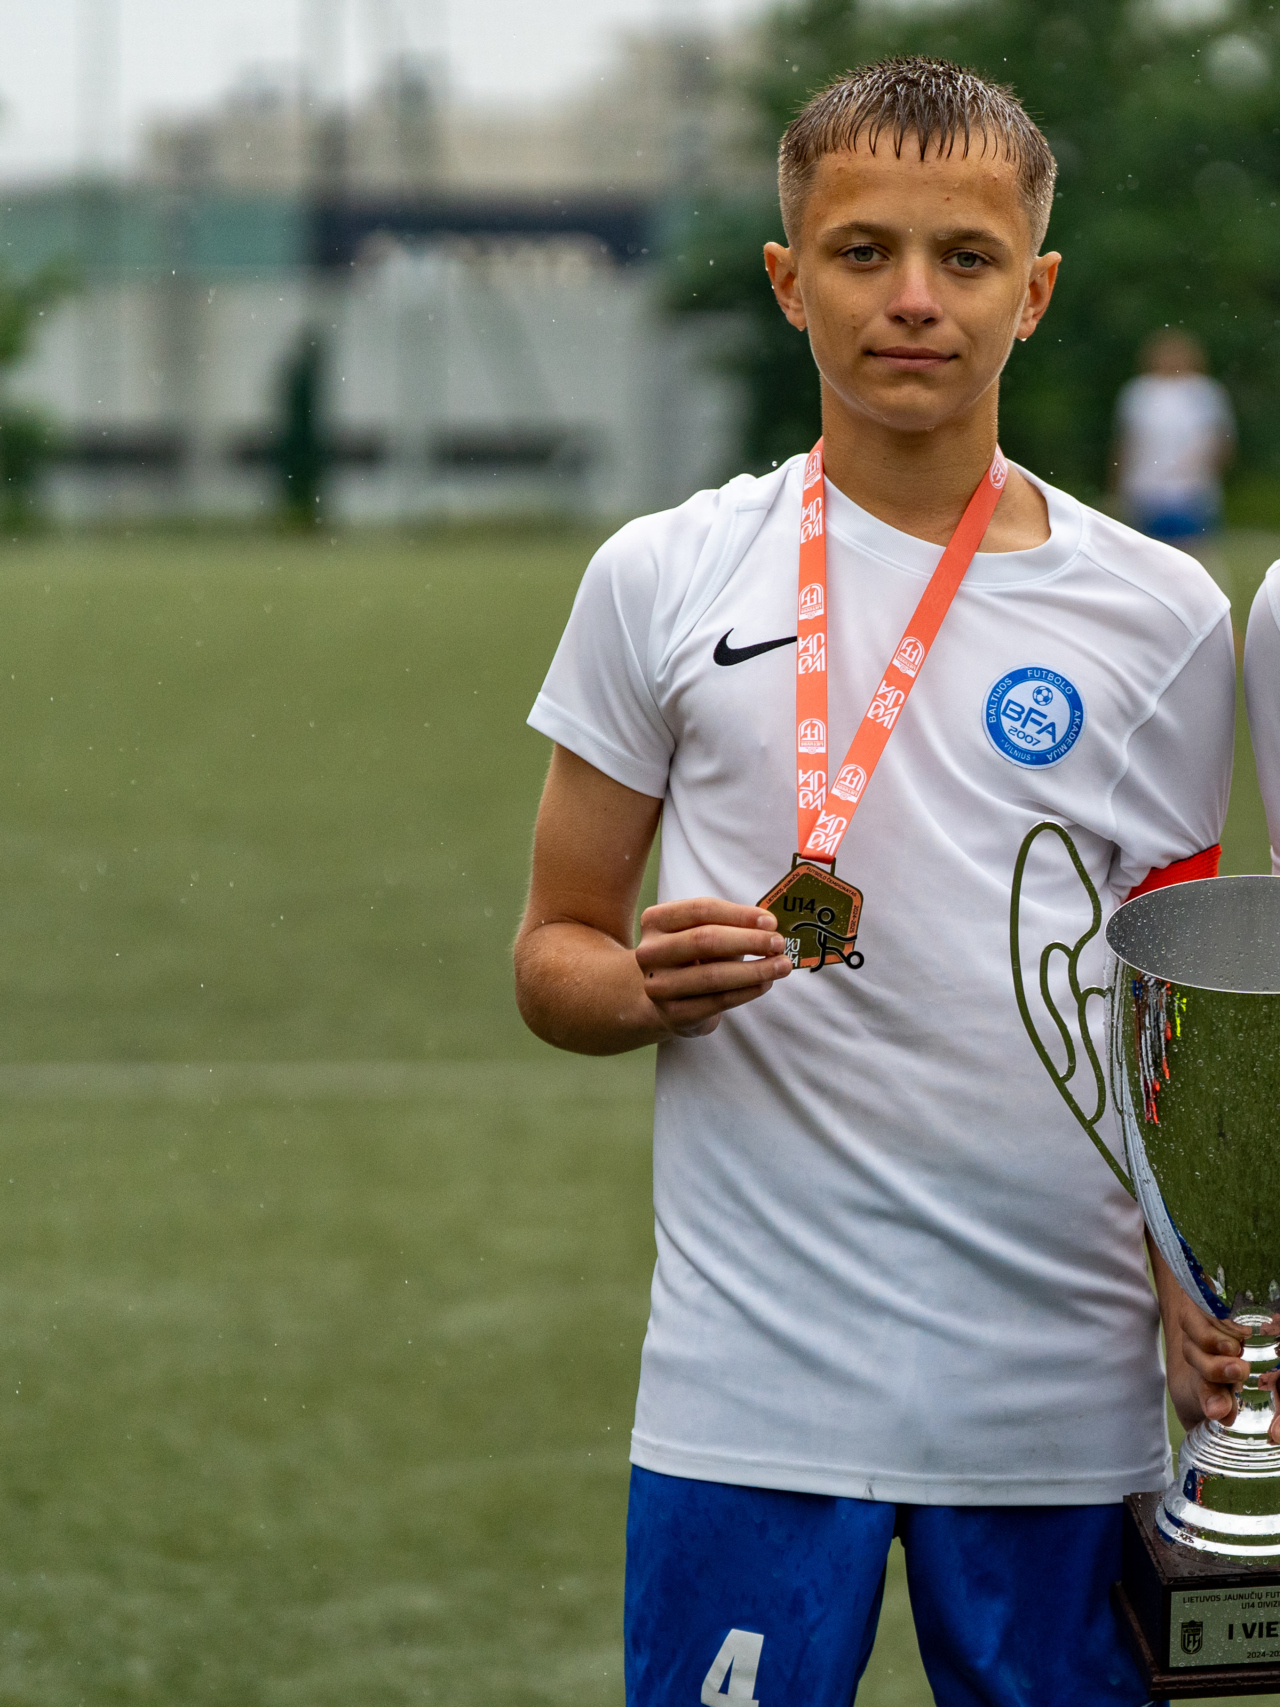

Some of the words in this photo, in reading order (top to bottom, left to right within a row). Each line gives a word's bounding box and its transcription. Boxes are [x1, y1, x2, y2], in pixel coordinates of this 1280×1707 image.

[1027, 669, 1074, 695] FUTBOLO
[988, 677, 1013, 723] BALTIJOS
[1001, 698, 1057, 744] BFA
[1007, 725, 1042, 747] 2007
[1046, 709, 1081, 761] AKADEMIJA
[1003, 741, 1031, 761] VILNIUS
[783, 895, 816, 914] U14
[1182, 1594, 1221, 1604] LIETUVOS
[1222, 1591, 1263, 1601] JAUNUČIŲ
[1241, 1602, 1255, 1610] U14
[1228, 1623, 1234, 1640] I
[701, 1628, 764, 1707] 4
